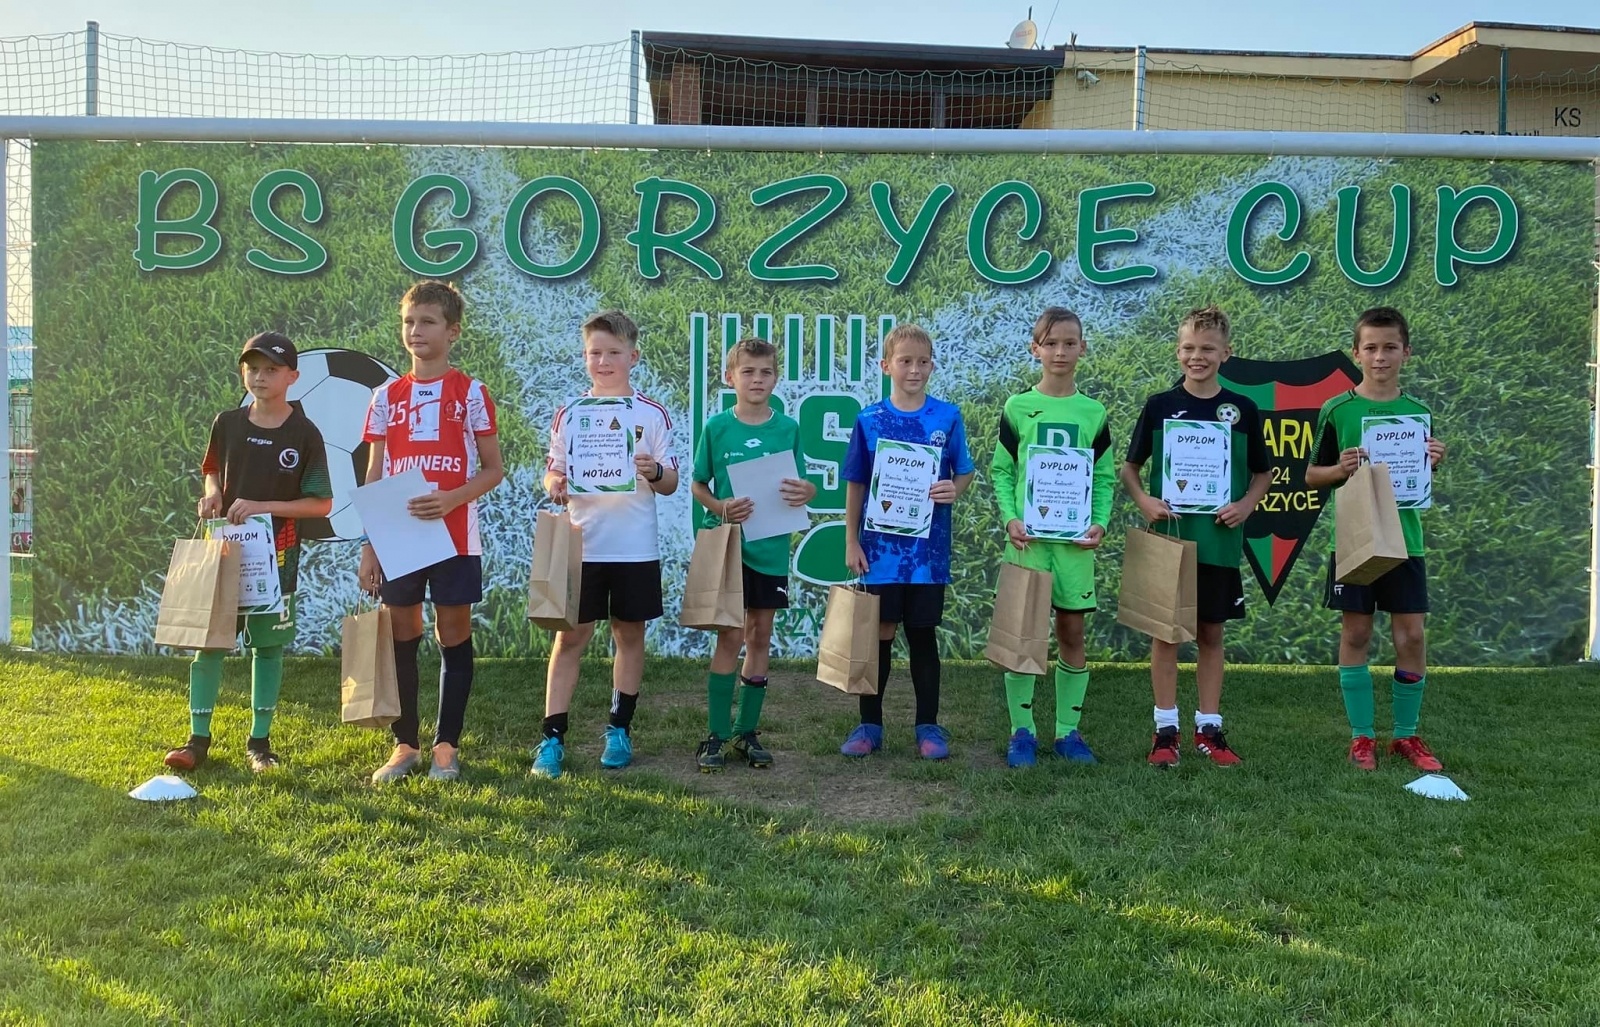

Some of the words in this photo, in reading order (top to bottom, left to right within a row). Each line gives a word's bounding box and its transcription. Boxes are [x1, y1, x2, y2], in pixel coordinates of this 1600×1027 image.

[1554, 107, 1581, 128] KS
[135, 167, 328, 276] BS
[392, 172, 1159, 287] GORZYCE
[1225, 180, 1520, 288] CUP
[387, 401, 407, 427] 25
[1177, 435, 1216, 445] DYPLOM
[1376, 431, 1416, 441] DYPLOM
[393, 455, 462, 473] WINNERS
[887, 456, 925, 468] DYPLOM
[1040, 461, 1078, 472] DYPLOM
[582, 468, 622, 478] DYPLOM
[1271, 466, 1291, 485] 24
[1255, 490, 1321, 512] RZYCE
[222, 532, 258, 542] DYPLOM
